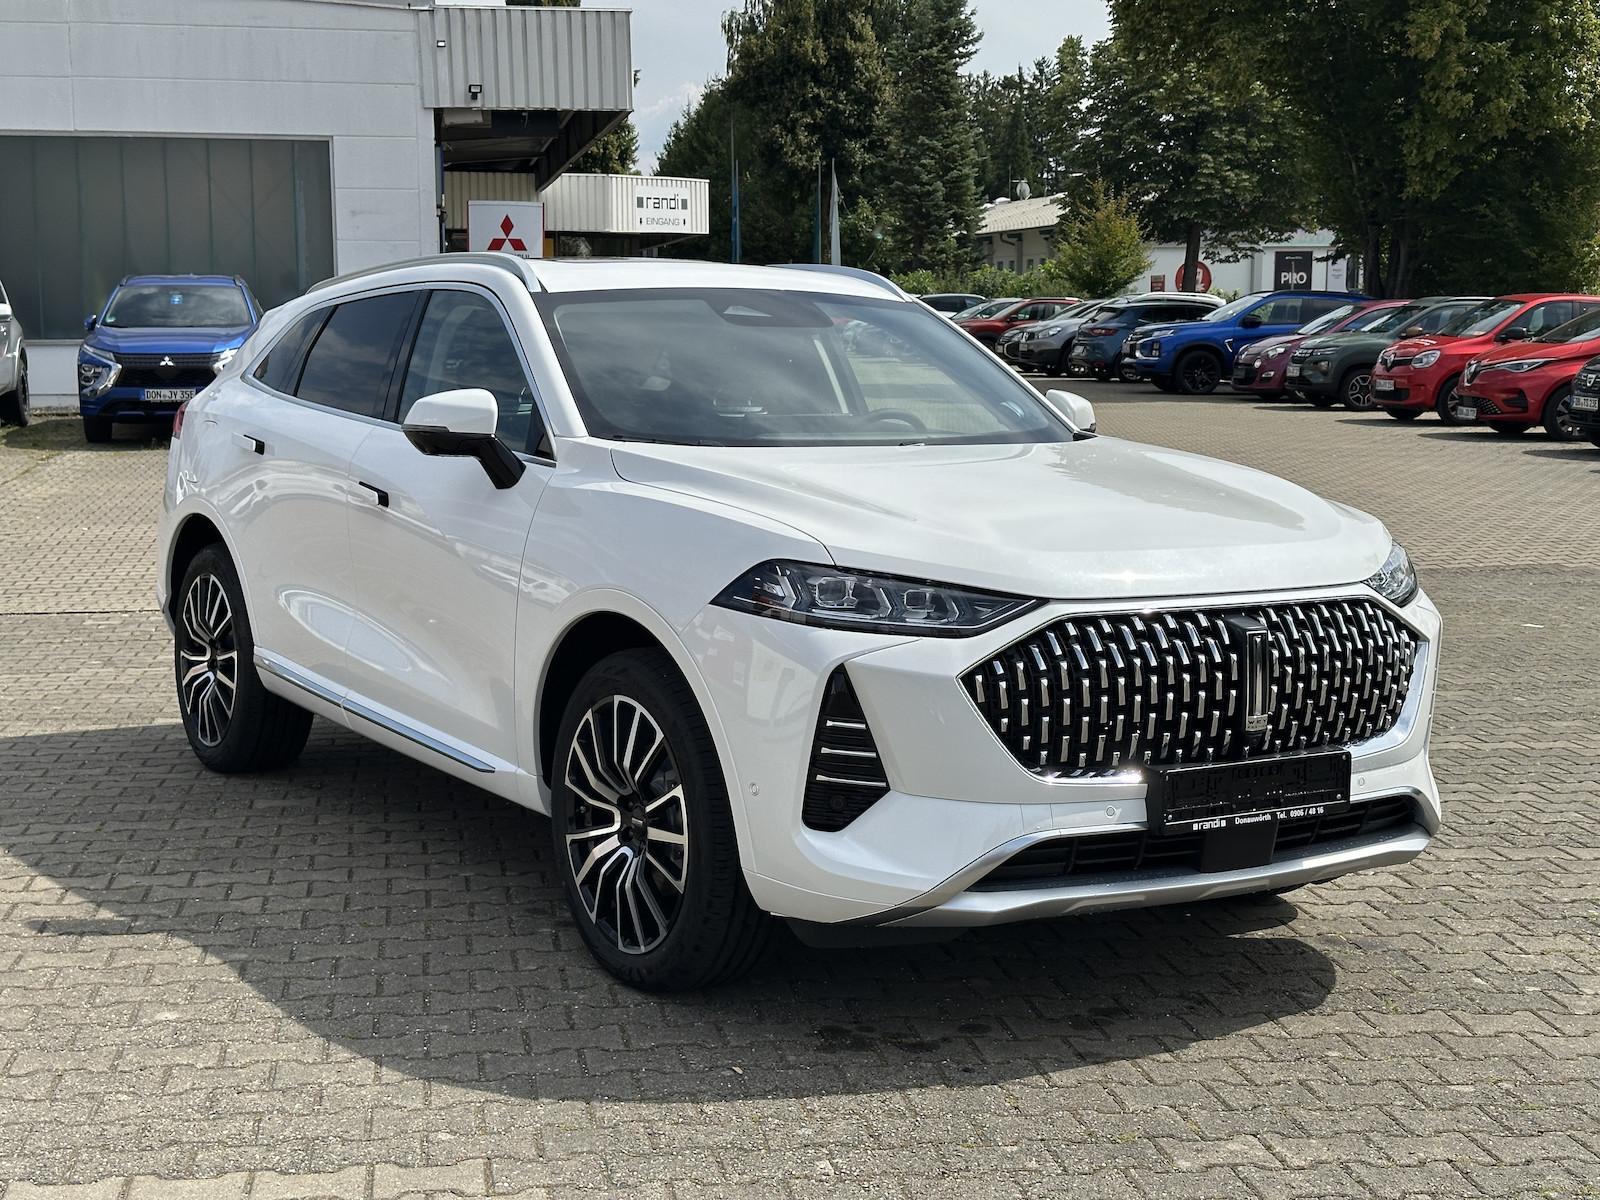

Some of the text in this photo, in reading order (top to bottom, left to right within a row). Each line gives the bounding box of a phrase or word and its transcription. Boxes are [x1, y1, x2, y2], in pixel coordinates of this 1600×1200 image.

[646, 193, 680, 210] randi
[646, 217, 680, 226] EINGANG
[146, 390, 162, 399] DON
[1198, 819, 1221, 830] randi
[1234, 813, 1272, 825] Donauwörth
[1276, 811, 1288, 820] Tel.
[1289, 809, 1304, 818] 0906
[1316, 806, 1324, 814] 16
